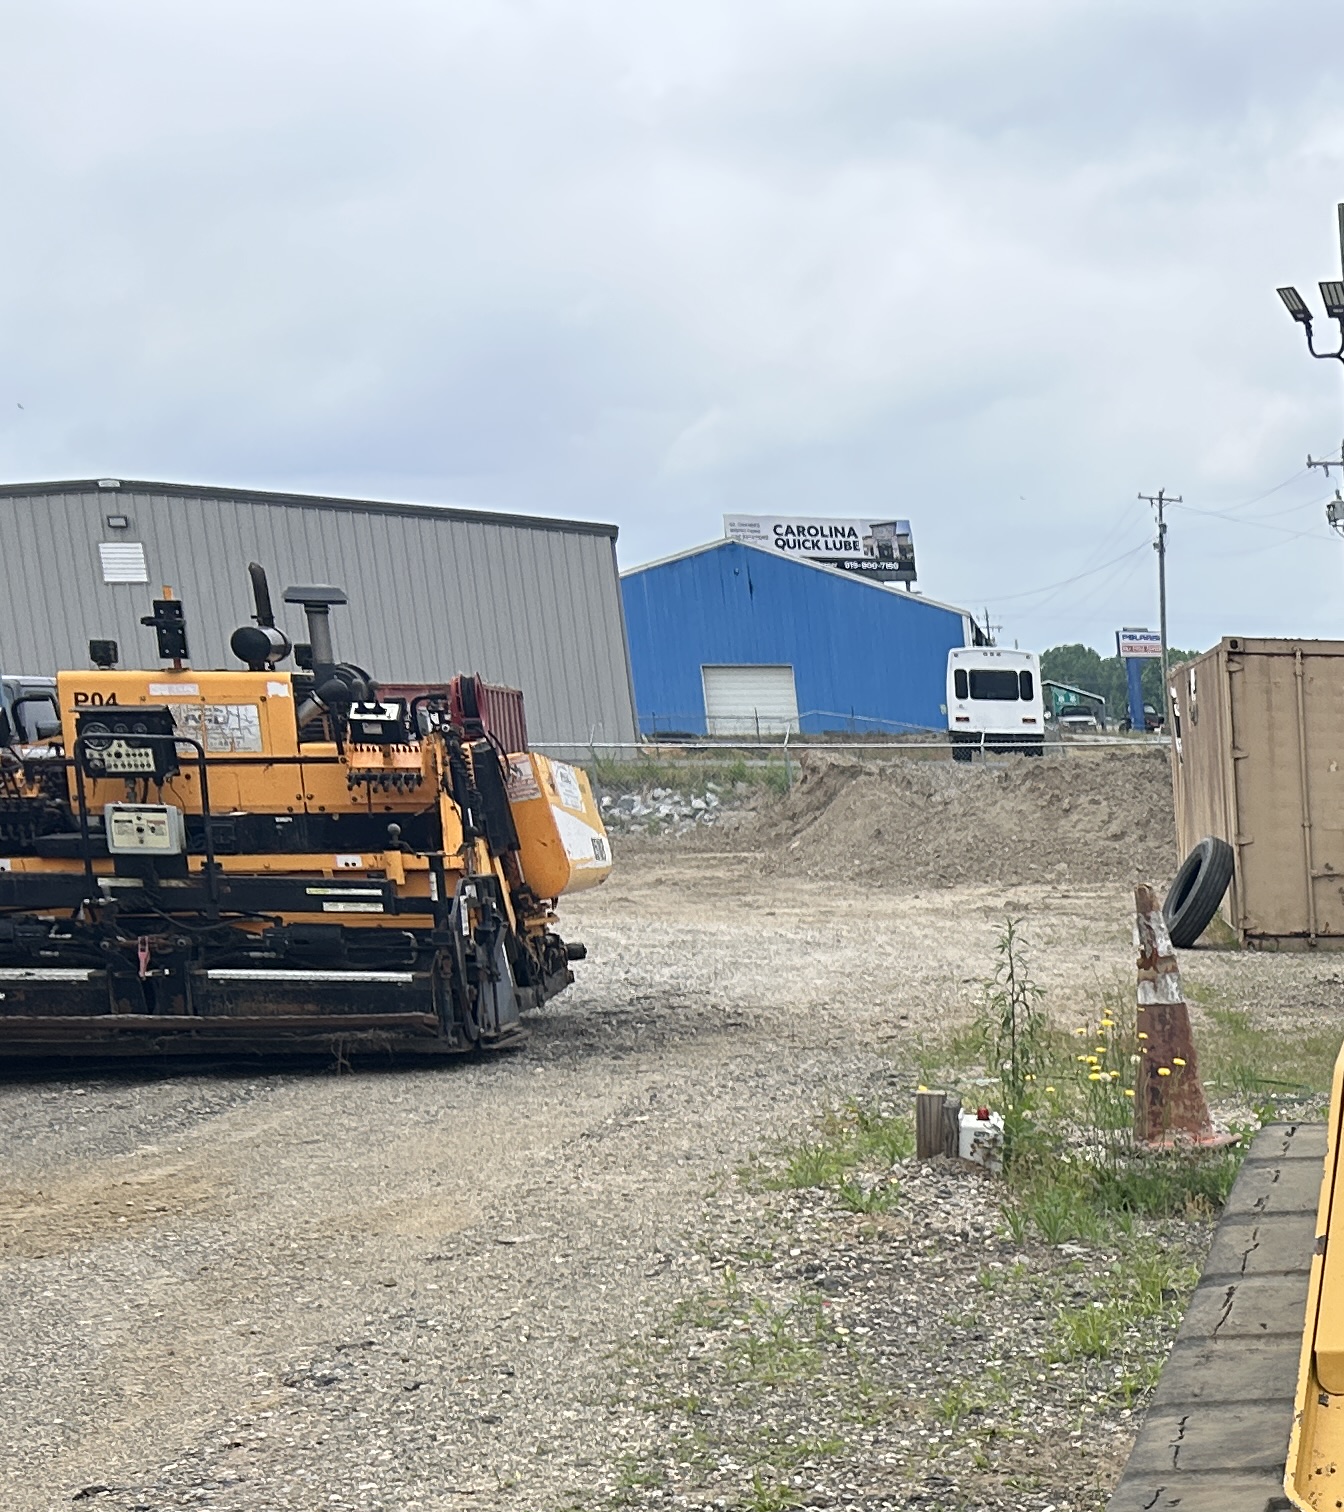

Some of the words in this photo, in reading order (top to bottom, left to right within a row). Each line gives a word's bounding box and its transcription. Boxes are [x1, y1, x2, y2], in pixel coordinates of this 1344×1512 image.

[773, 524, 858, 539] CAROLINA
[774, 537, 821, 551] QUICK
[825, 538, 860, 552] LUBE
